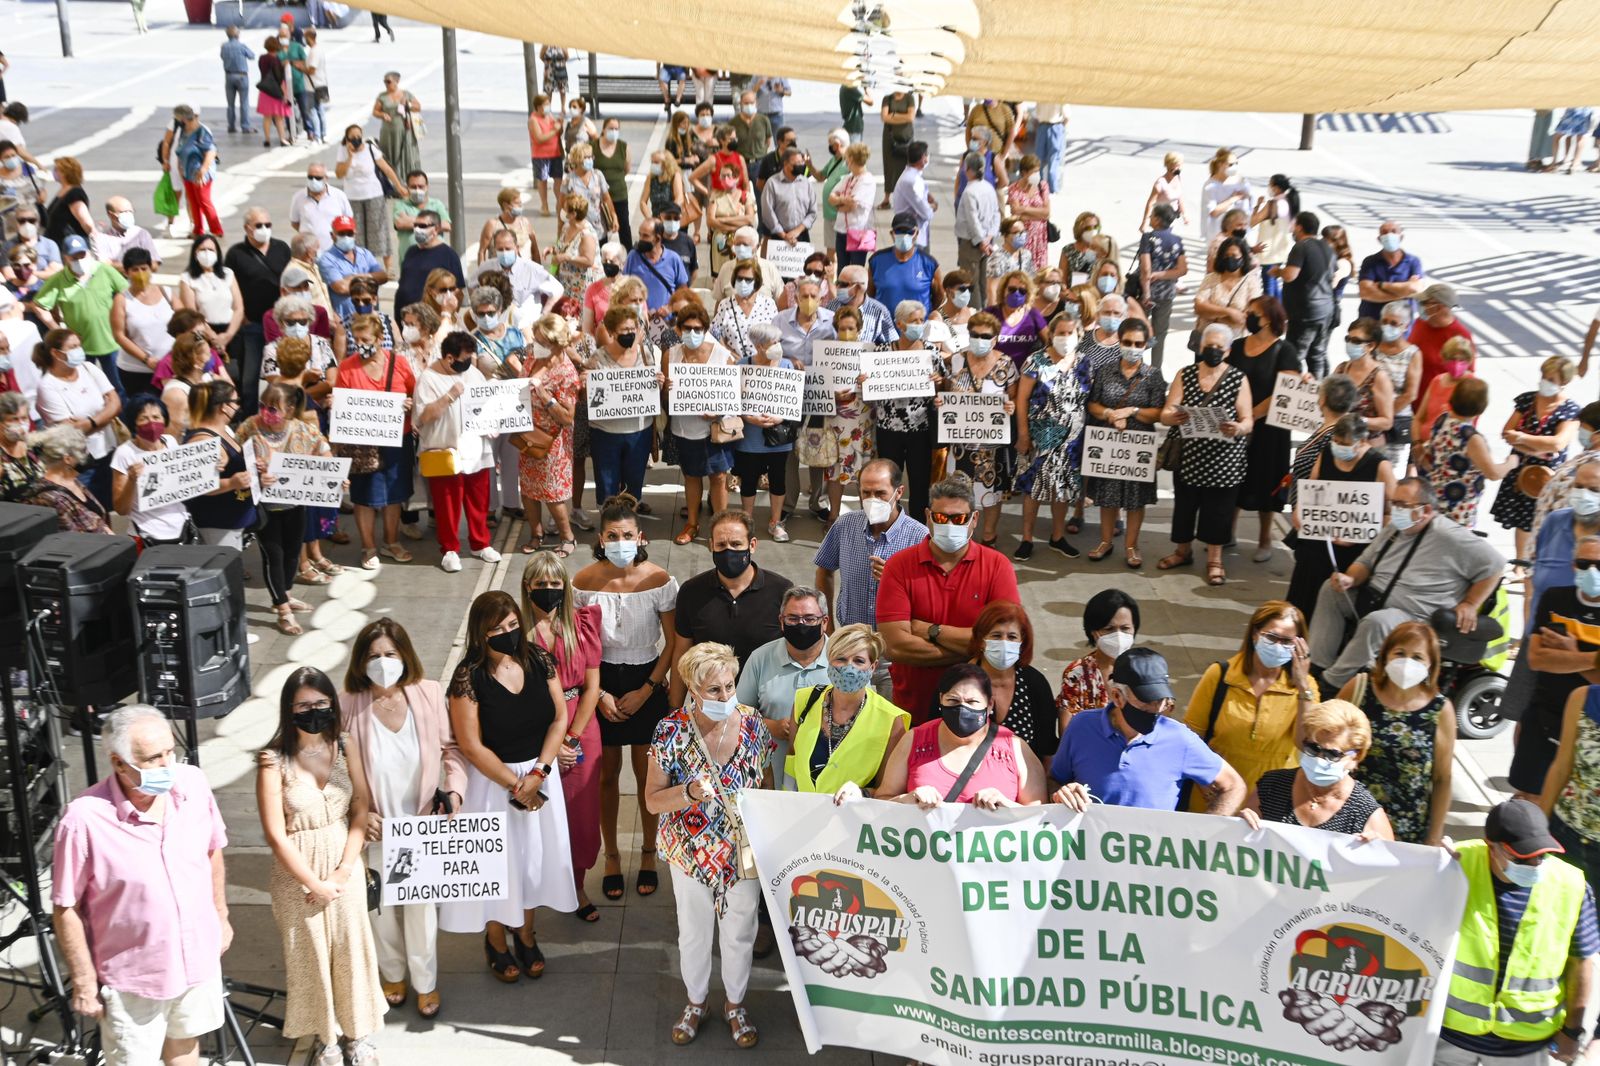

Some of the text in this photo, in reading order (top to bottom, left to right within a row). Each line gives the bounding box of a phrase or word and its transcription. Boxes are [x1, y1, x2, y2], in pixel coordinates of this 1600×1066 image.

[873, 356, 921, 366] QUEREMOS
[591, 368, 657, 382] NO QUEREMOS
[674, 366, 738, 377] NO QUEREMOS
[742, 368, 803, 382] NO QUEREMOS
[869, 368, 931, 379] AS CONSULTAS
[610, 380, 658, 393] TELÉFONOS
[679, 378, 733, 388] FOTOS PARA
[744, 380, 797, 393] FOTOS PARA
[868, 382, 931, 393] PRESENCIALES
[1280, 376, 1295, 390] NO
[622, 393, 644, 403] PARA
[676, 388, 736, 400] DIAGNÓSTICO
[741, 390, 798, 406] DIAGNÓSTICO
[803, 390, 834, 400] SONAL
[944, 394, 1005, 406] NO ATIENDEN
[346, 396, 394, 409] QUEREMOS
[674, 402, 740, 412] ESPECIALISTAS
[1297, 398, 1316, 413] LOS
[596, 404, 656, 418] DIAGNOSTICAR
[741, 402, 800, 418] SPECIALISTAS
[965, 411, 985, 422] LOS
[335, 411, 402, 424] LAS CONSULTAS
[336, 426, 400, 439] PRESENCIALES
[946, 426, 1004, 440] TELÉFONOS
[1090, 429, 1156, 446] NO ATIENDEN
[142, 440, 217, 466] NO QUEREMOS
[1110, 448, 1131, 460] LOS
[282, 458, 341, 473] DEFENDAMOS
[1090, 462, 1148, 478] TELÉFONOS
[178, 471, 203, 485] PARA
[302, 476, 314, 486] LA
[148, 480, 216, 507] DIAGNOSTICAR
[264, 487, 304, 501] SANIDAD
[1337, 490, 1370, 506] MÁS
[1302, 508, 1380, 525] PERSONAL
[1302, 524, 1378, 540] SANITARIO
[392, 817, 500, 837] NO QUEREMOS
[422, 836, 504, 856] TELÉFONOS
[856, 821, 1331, 892] ASOCIACIÓN GRANADINA
[443, 860, 480, 876] PARA
[397, 881, 501, 902] DIAGNOSTICAR
[771, 856, 810, 887] Granadina
[810, 853, 822, 862] de
[824, 852, 866, 872] Usuarios
[867, 866, 880, 880] de
[880, 876, 891, 886] la
[891, 884, 922, 920] Sanidad
[962, 879, 1218, 922] DE USUARIOS
[792, 906, 912, 938] AGRUSPAR
[1273, 904, 1322, 940] Granadina
[1324, 902, 1338, 913] de
[1340, 902, 1392, 926] Usuarios
[1036, 928, 1146, 965] DE LA
[1291, 966, 1438, 1003] AGRUSPAR
[929, 966, 1264, 1032] SANIDAD PÚBLICA
[920, 1032, 973, 1060] e-mail:
